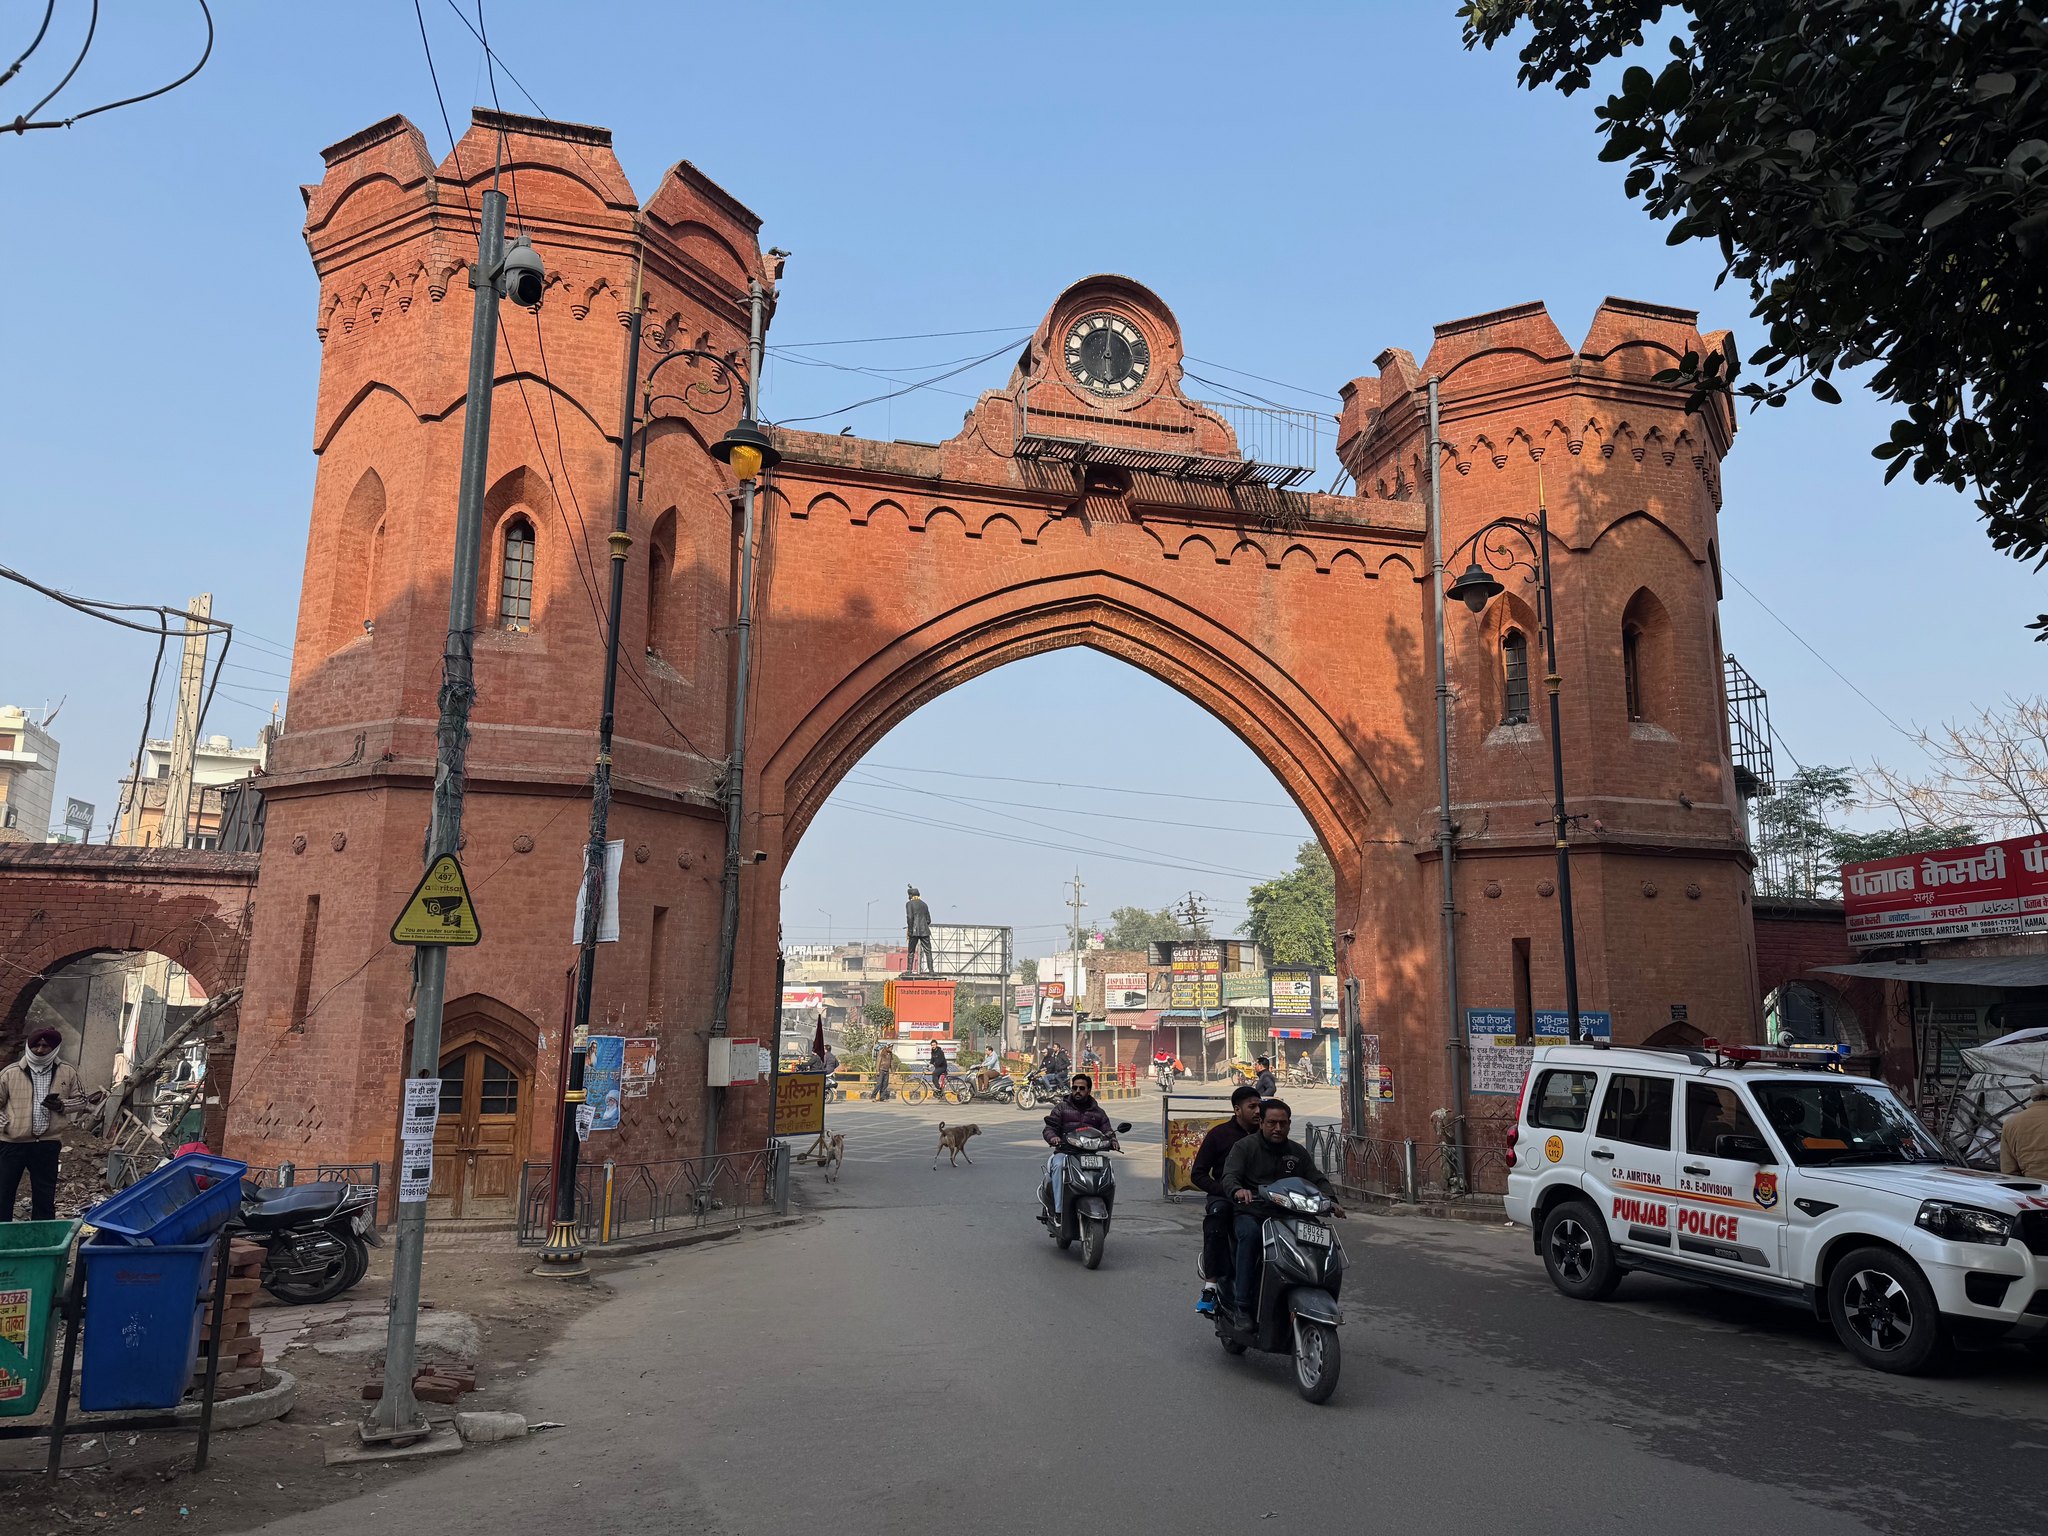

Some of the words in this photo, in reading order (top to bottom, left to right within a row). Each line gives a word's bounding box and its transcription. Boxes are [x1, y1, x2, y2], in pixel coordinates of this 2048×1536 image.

[68, 803, 93, 824] Ruby
[1848, 867, 1915, 896] पंजाब
[1920, 846, 2007, 887] केसरी
[425, 884, 463, 892] aritsar
[1913, 892, 1935, 905] समूह
[1850, 916, 1864, 927] पंजाब
[1864, 913, 1881, 926] केसरी
[2025, 916, 2047, 927] KAMAL
[1850, 932, 1869, 943] KAMAL
[1869, 929, 1895, 941] KISHORE
[1895, 926, 1935, 939] ADVERTISER,
[1936, 924, 1969, 935] AMRITSAR
[1173, 949, 1194, 957] GURU
[1226, 971, 1264, 979] DARGAH
[1537, 1014, 1569, 1026] ਅੰਮ੍ਰਿਤਸ
[1611, 1167, 1624, 1179] C.P.
[1626, 1170, 1661, 1185] AMRITSAR
[1680, 1179, 1693, 1191] P.S.
[1695, 1181, 1733, 1197] E-DIVISION
[1611, 1197, 1667, 1228] PUNJAB
[1678, 1208, 1740, 1242] POLICE
